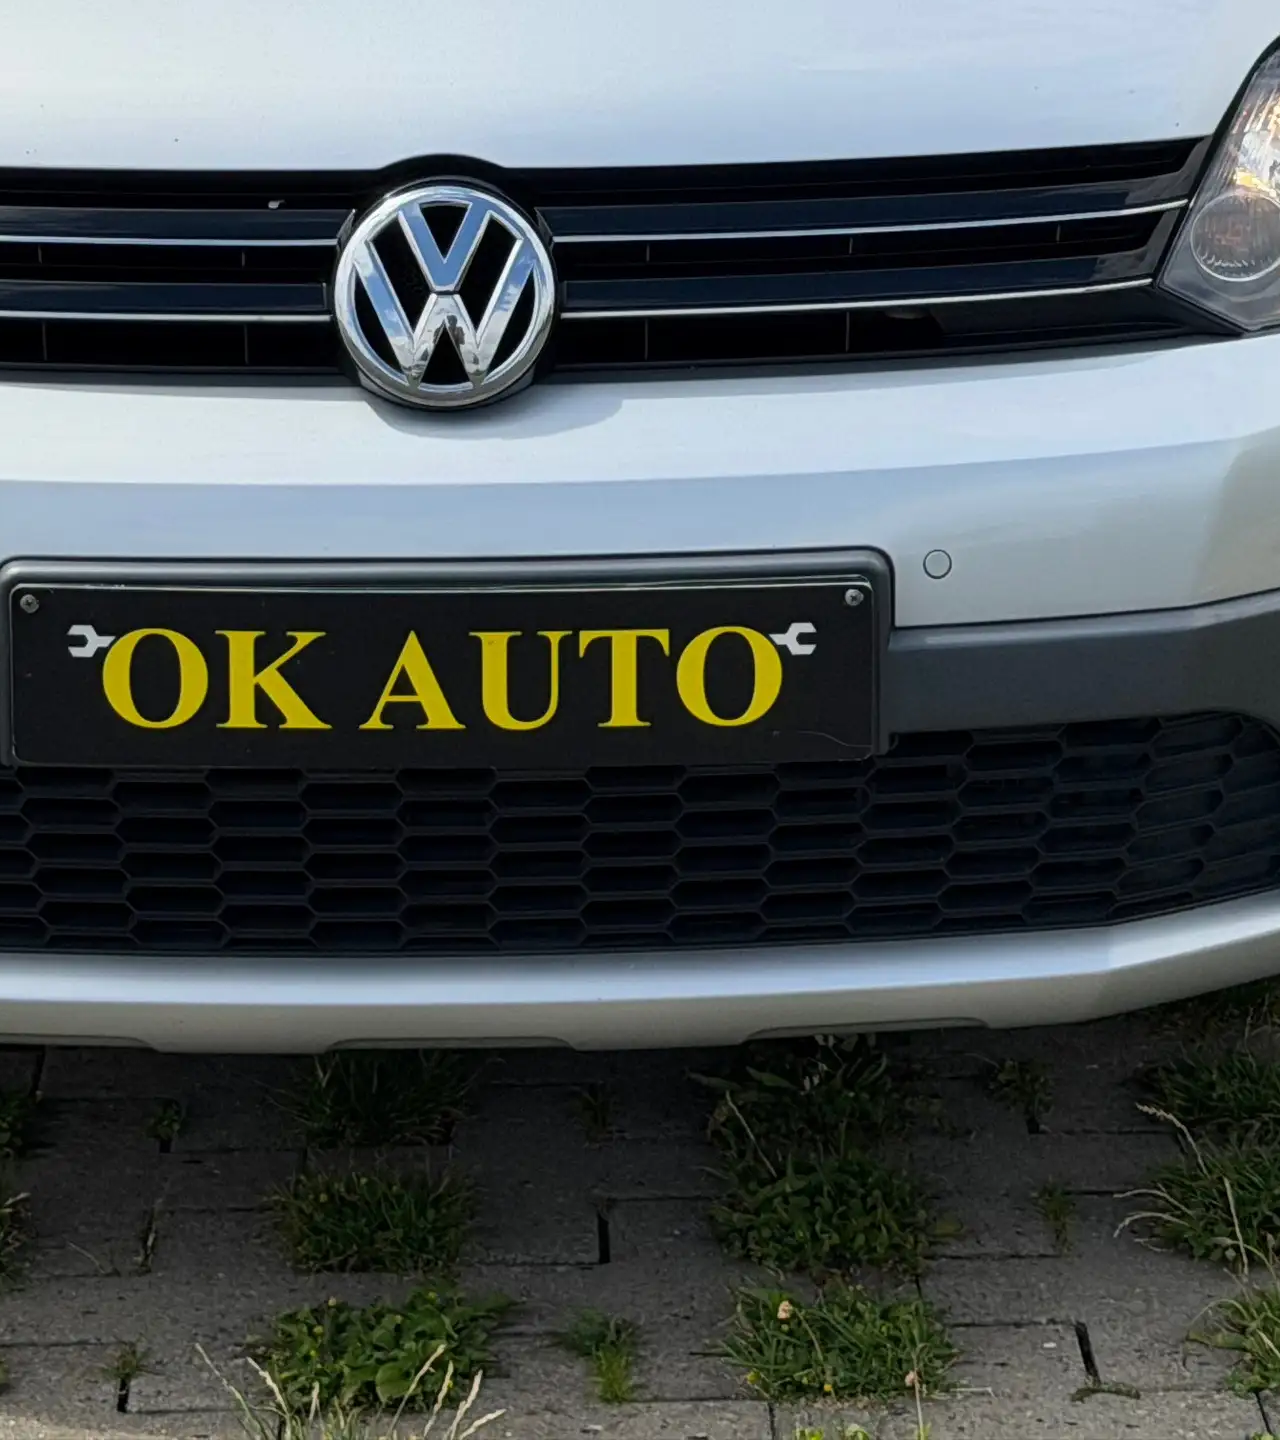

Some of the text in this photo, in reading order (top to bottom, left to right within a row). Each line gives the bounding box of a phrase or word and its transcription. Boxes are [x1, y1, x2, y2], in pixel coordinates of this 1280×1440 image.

[350, 198, 538, 390] VW
[102, 625, 784, 731] OK AUTO
